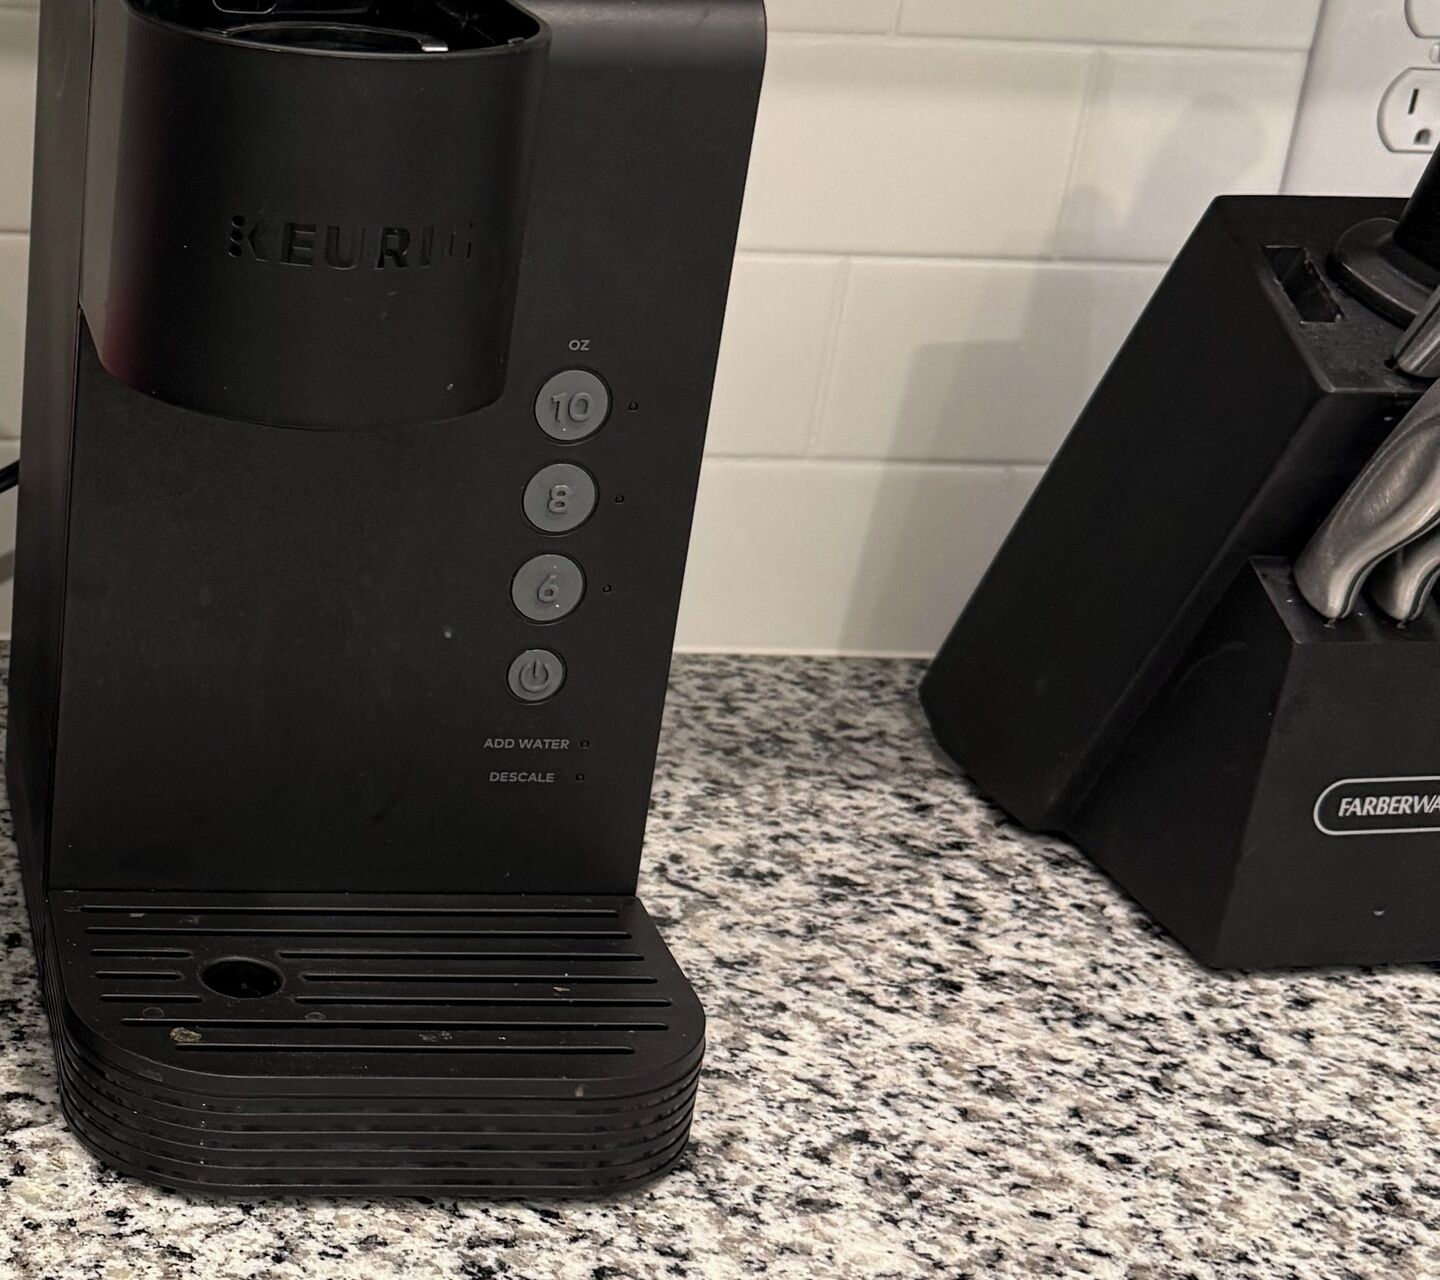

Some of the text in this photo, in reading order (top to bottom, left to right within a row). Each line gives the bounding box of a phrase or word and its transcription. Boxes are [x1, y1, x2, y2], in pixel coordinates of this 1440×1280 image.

[568, 339, 591, 351] OZ
[551, 392, 592, 422] 10
[547, 484, 570, 514] 8
[537, 573, 559, 603] 6
[484, 738, 570, 749] ADD WATER
[489, 772, 555, 782] DESCALE
